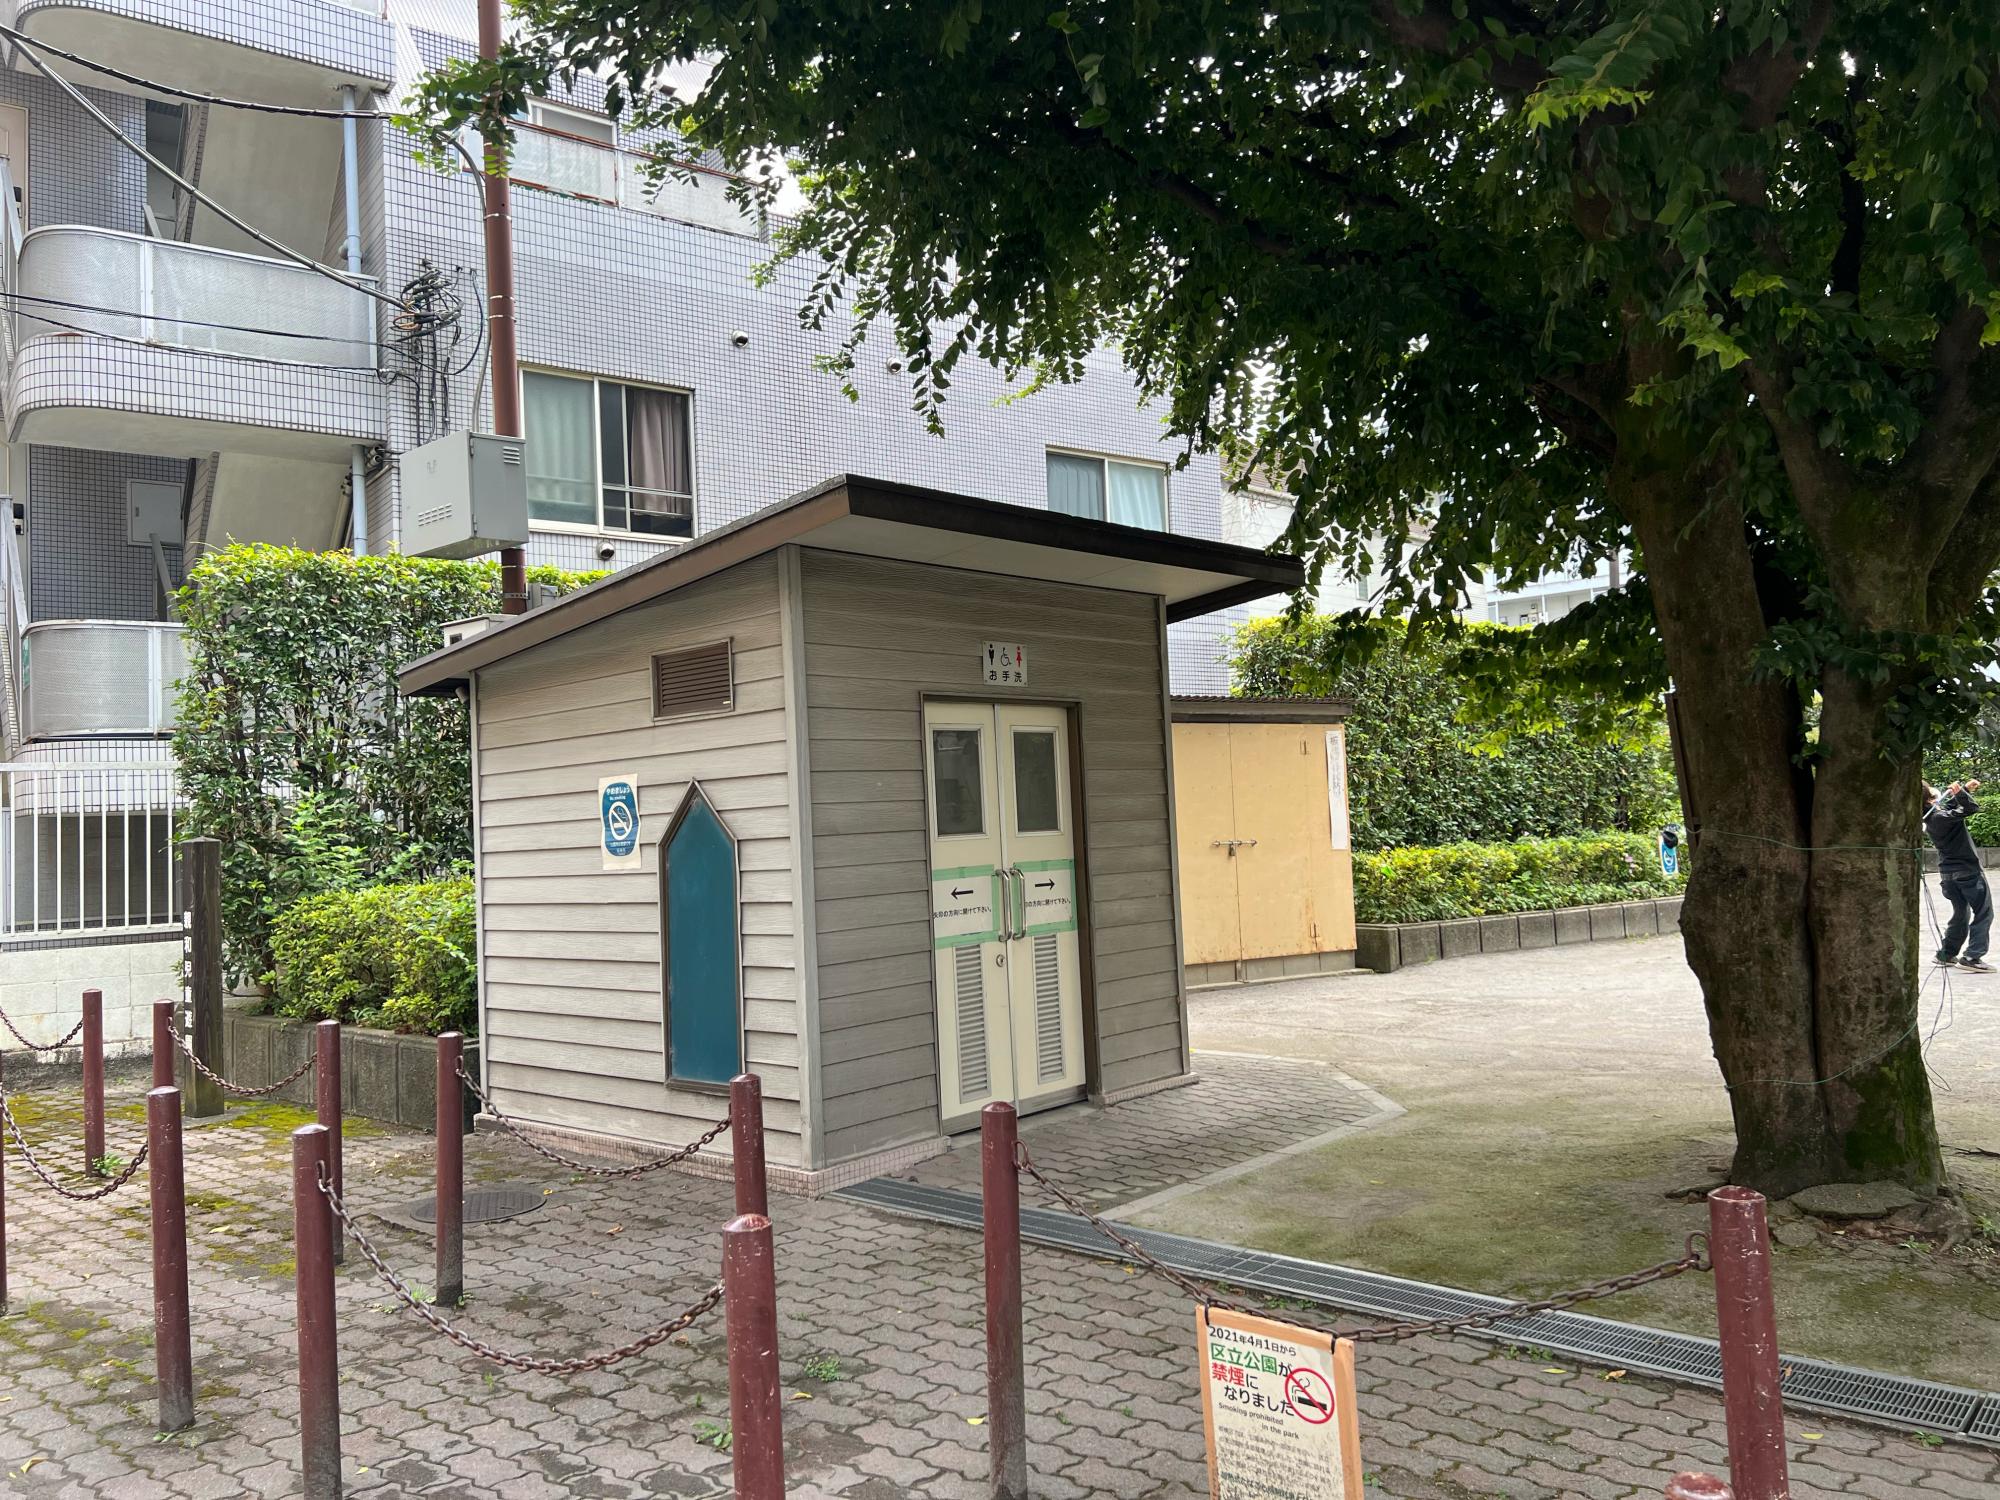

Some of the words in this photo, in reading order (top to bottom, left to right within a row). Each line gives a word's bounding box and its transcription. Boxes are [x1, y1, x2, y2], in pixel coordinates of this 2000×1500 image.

[989, 670, 1023, 683] お手洗
[1209, 1327, 1296, 1356] 2021年4月1日から
[1210, 1342, 1293, 1377] 区立公園が
[1211, 1361, 1259, 1390] 禁煙に
[1218, 1402, 1248, 1418] Smoking
[1248, 1410, 1284, 1426] prohibited
[1224, 1384, 1295, 1417] なりました
[1261, 1422, 1269, 1431] in
[1270, 1425, 1282, 1435] the
[1283, 1429, 1300, 1440] park
